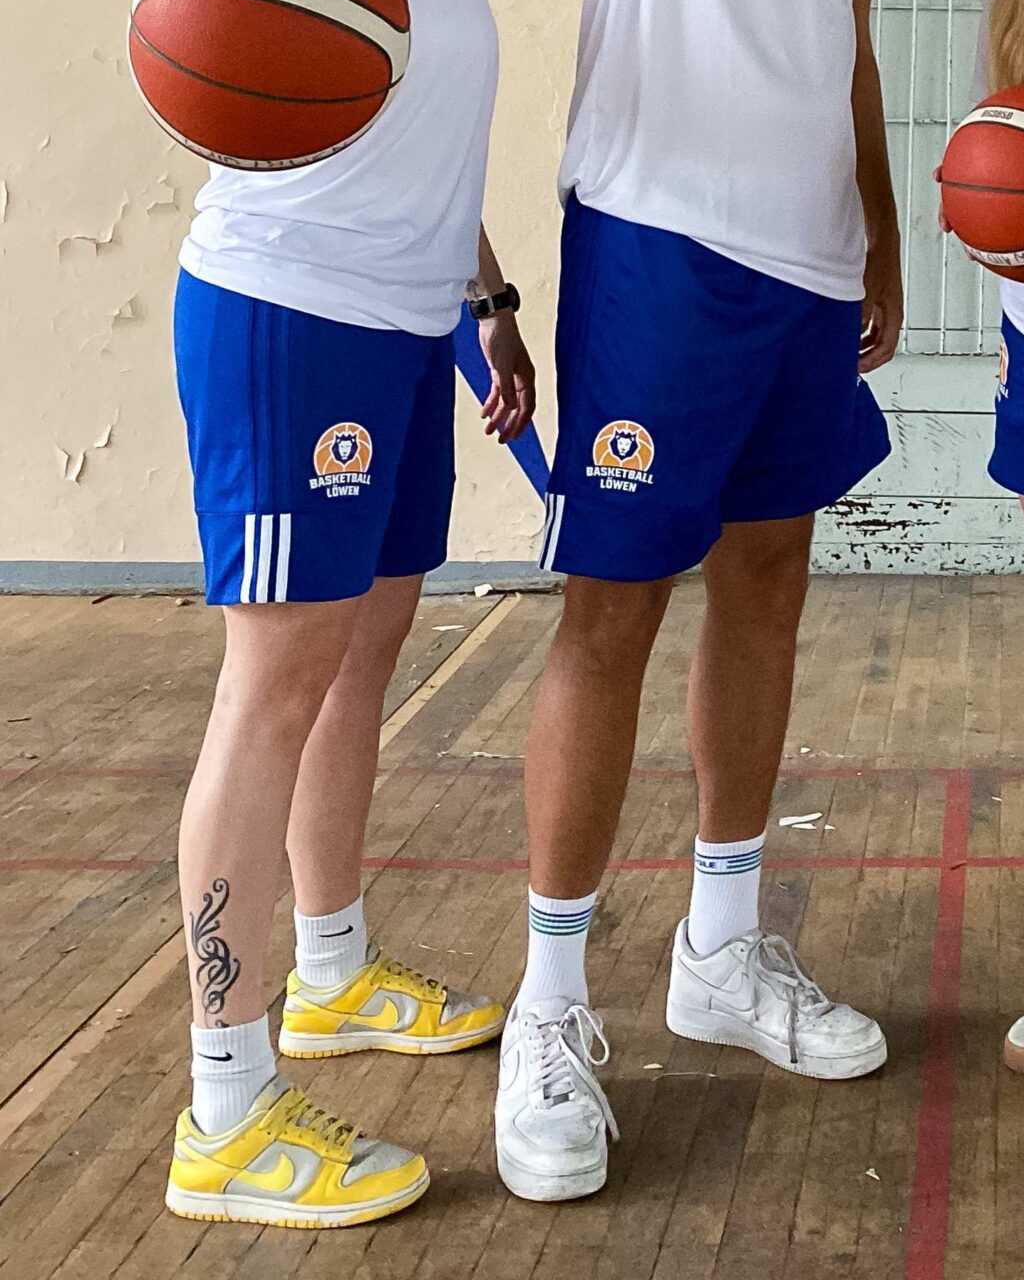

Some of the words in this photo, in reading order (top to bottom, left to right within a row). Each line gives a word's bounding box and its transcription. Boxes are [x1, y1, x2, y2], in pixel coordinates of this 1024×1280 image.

[309, 473, 371, 490] BASKETBALL
[586, 466, 653, 484] BASKETBALL
[326, 484, 360, 498] LÖWEN
[600, 477, 637, 493] LÖWEN
